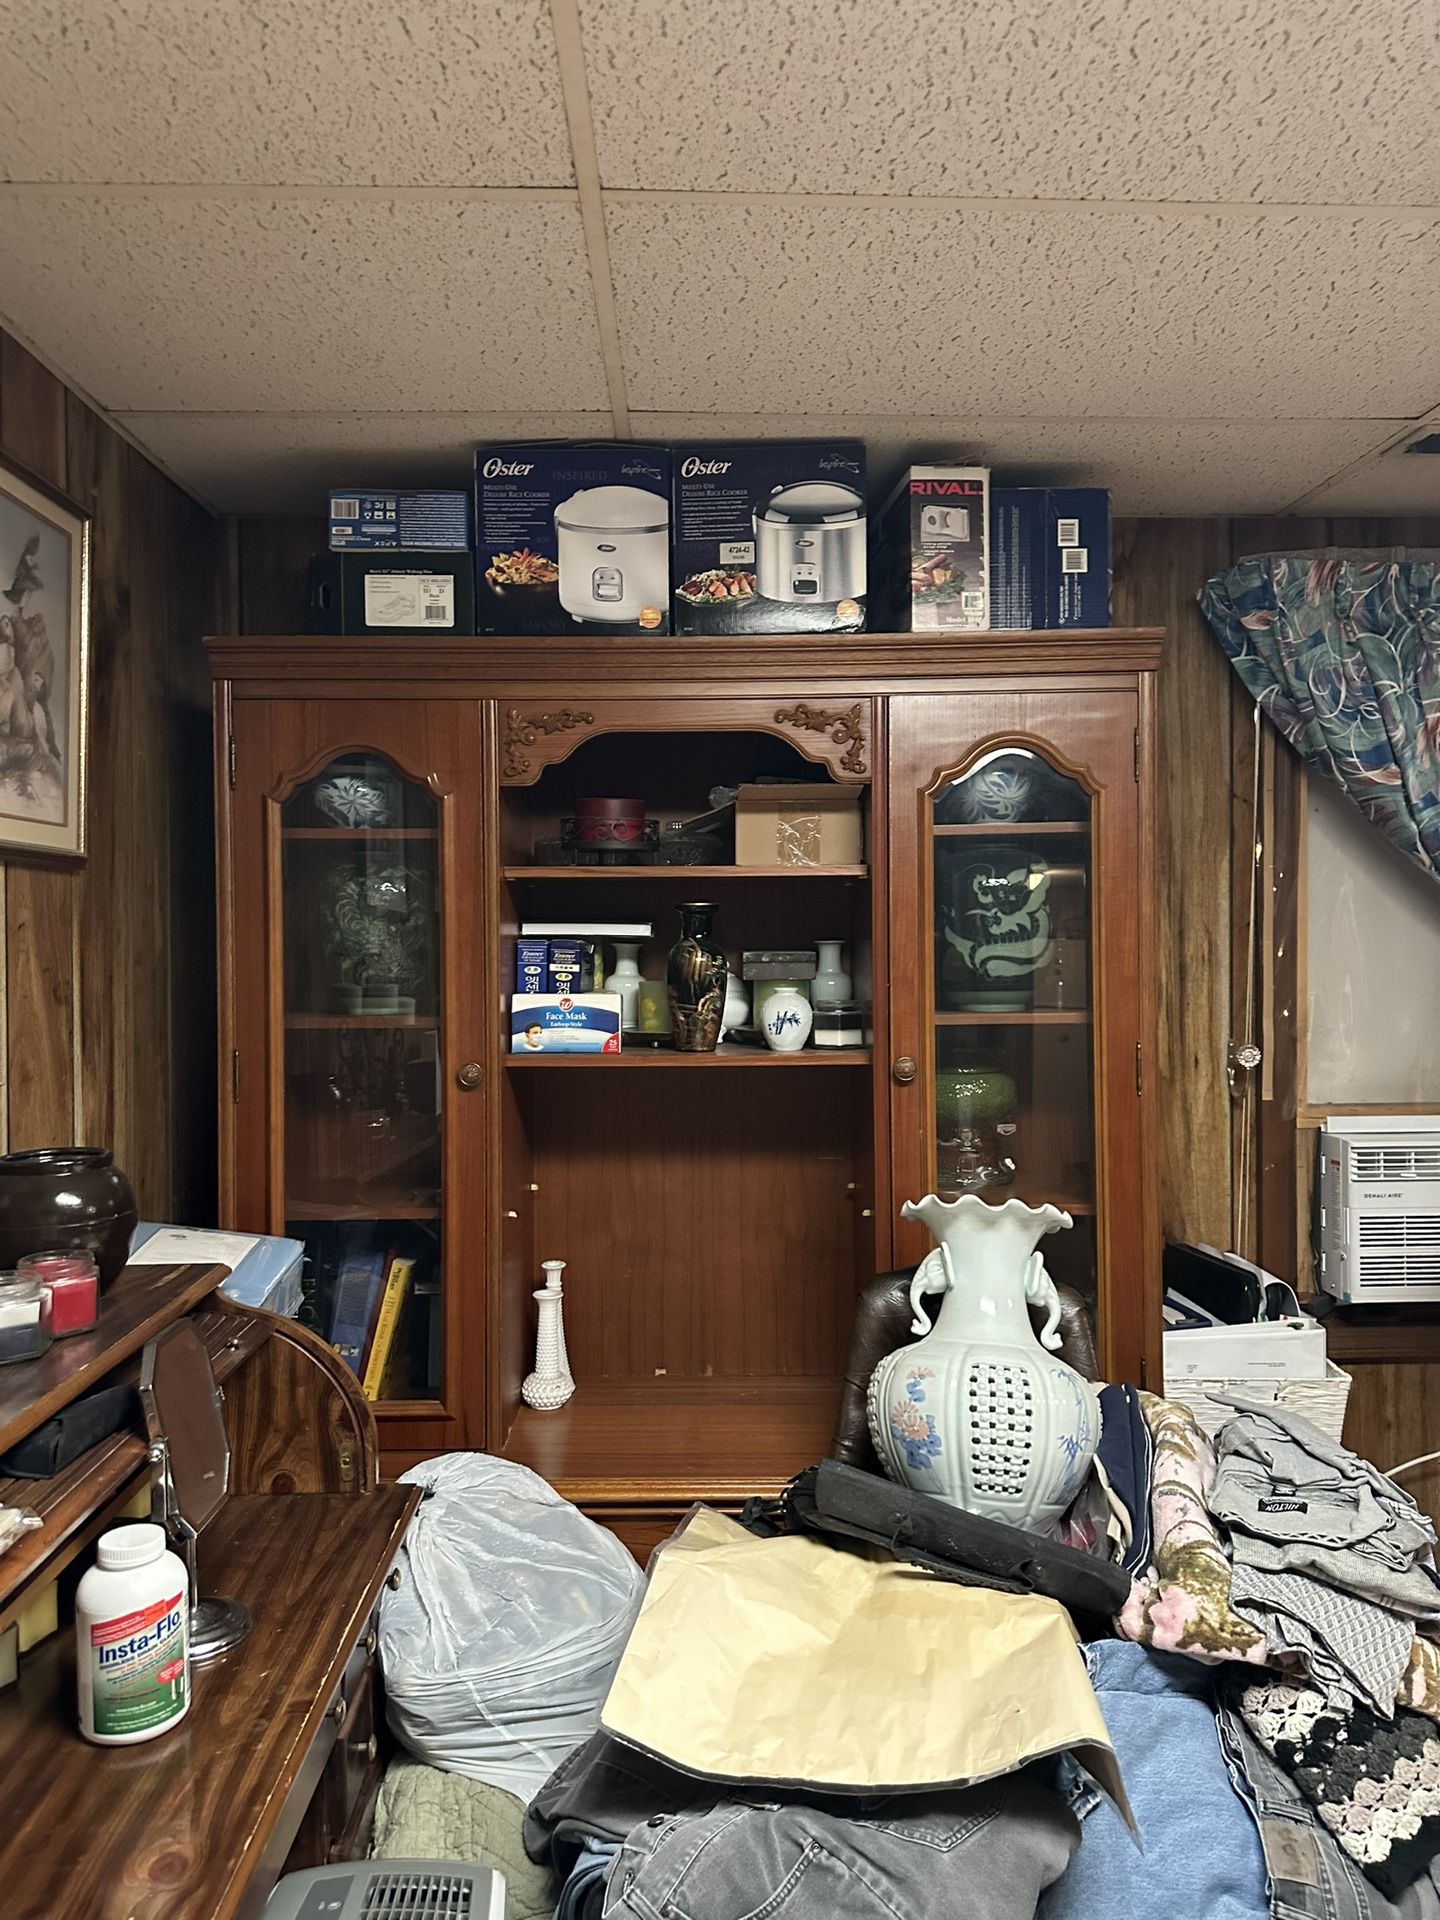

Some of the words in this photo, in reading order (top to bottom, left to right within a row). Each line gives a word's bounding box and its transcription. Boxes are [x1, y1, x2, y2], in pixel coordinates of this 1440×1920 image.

[482, 456, 535, 479] Oster
[681, 456, 732, 478] Oster
[546, 1012, 563, 1020] Face
[566, 1011, 588, 1020] Mask
[99, 1610, 181, 1665] Insta-Flo
